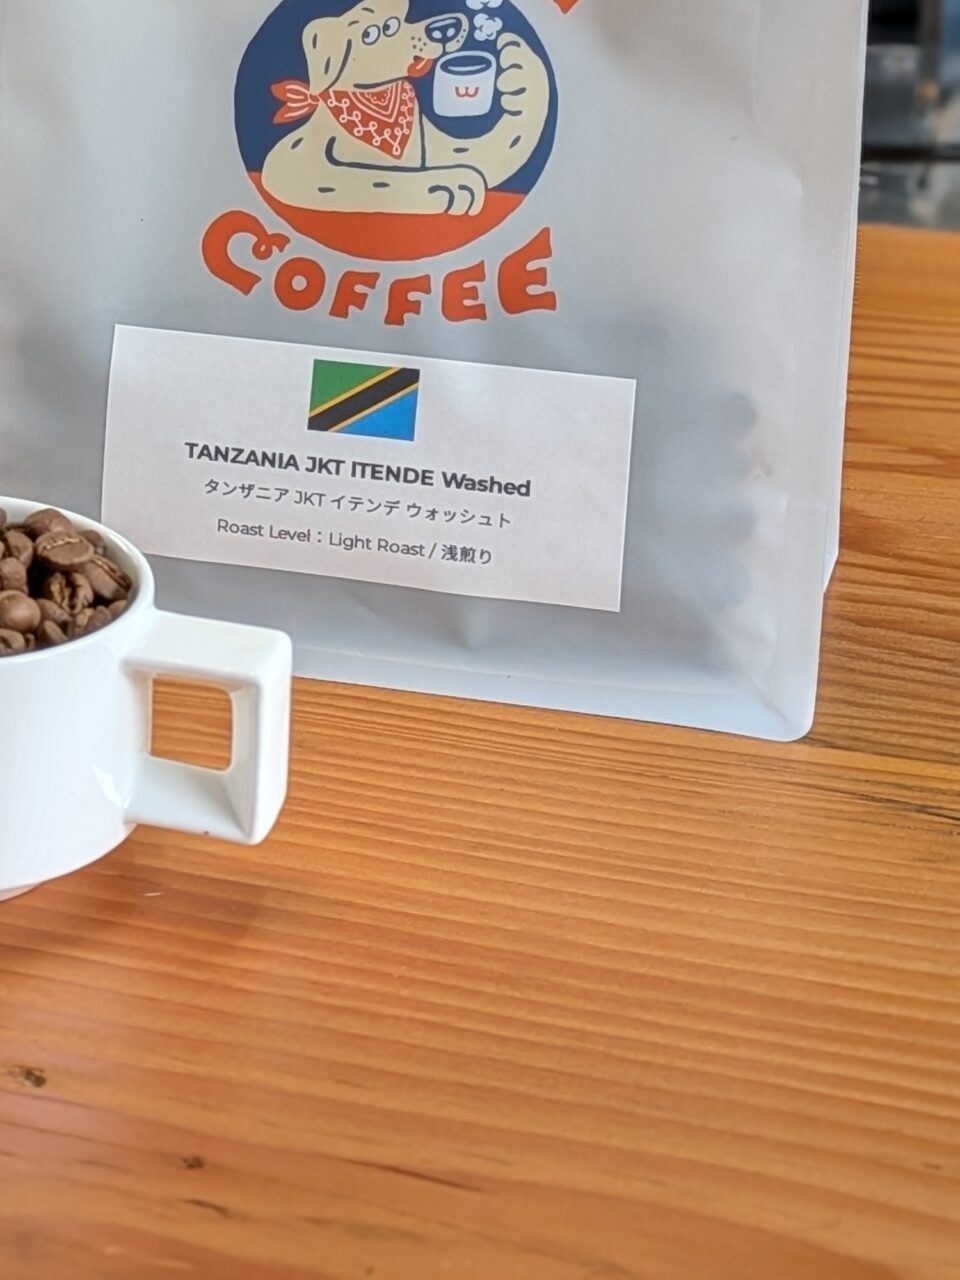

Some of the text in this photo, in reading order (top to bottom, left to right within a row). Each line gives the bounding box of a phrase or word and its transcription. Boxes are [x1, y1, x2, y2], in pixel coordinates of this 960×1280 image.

[201, 210, 557, 326] COFFEE
[184, 441, 532, 498] TANZANIA JKT ITENDE Washed
[204, 478, 511, 529] タンザニア JKT イテンデ ウォッシュト
[216, 519, 265, 539] Roast
[329, 531, 373, 553] Light
[376, 538, 426, 557] Roast
[441, 544, 493, 566] 浅煎り
